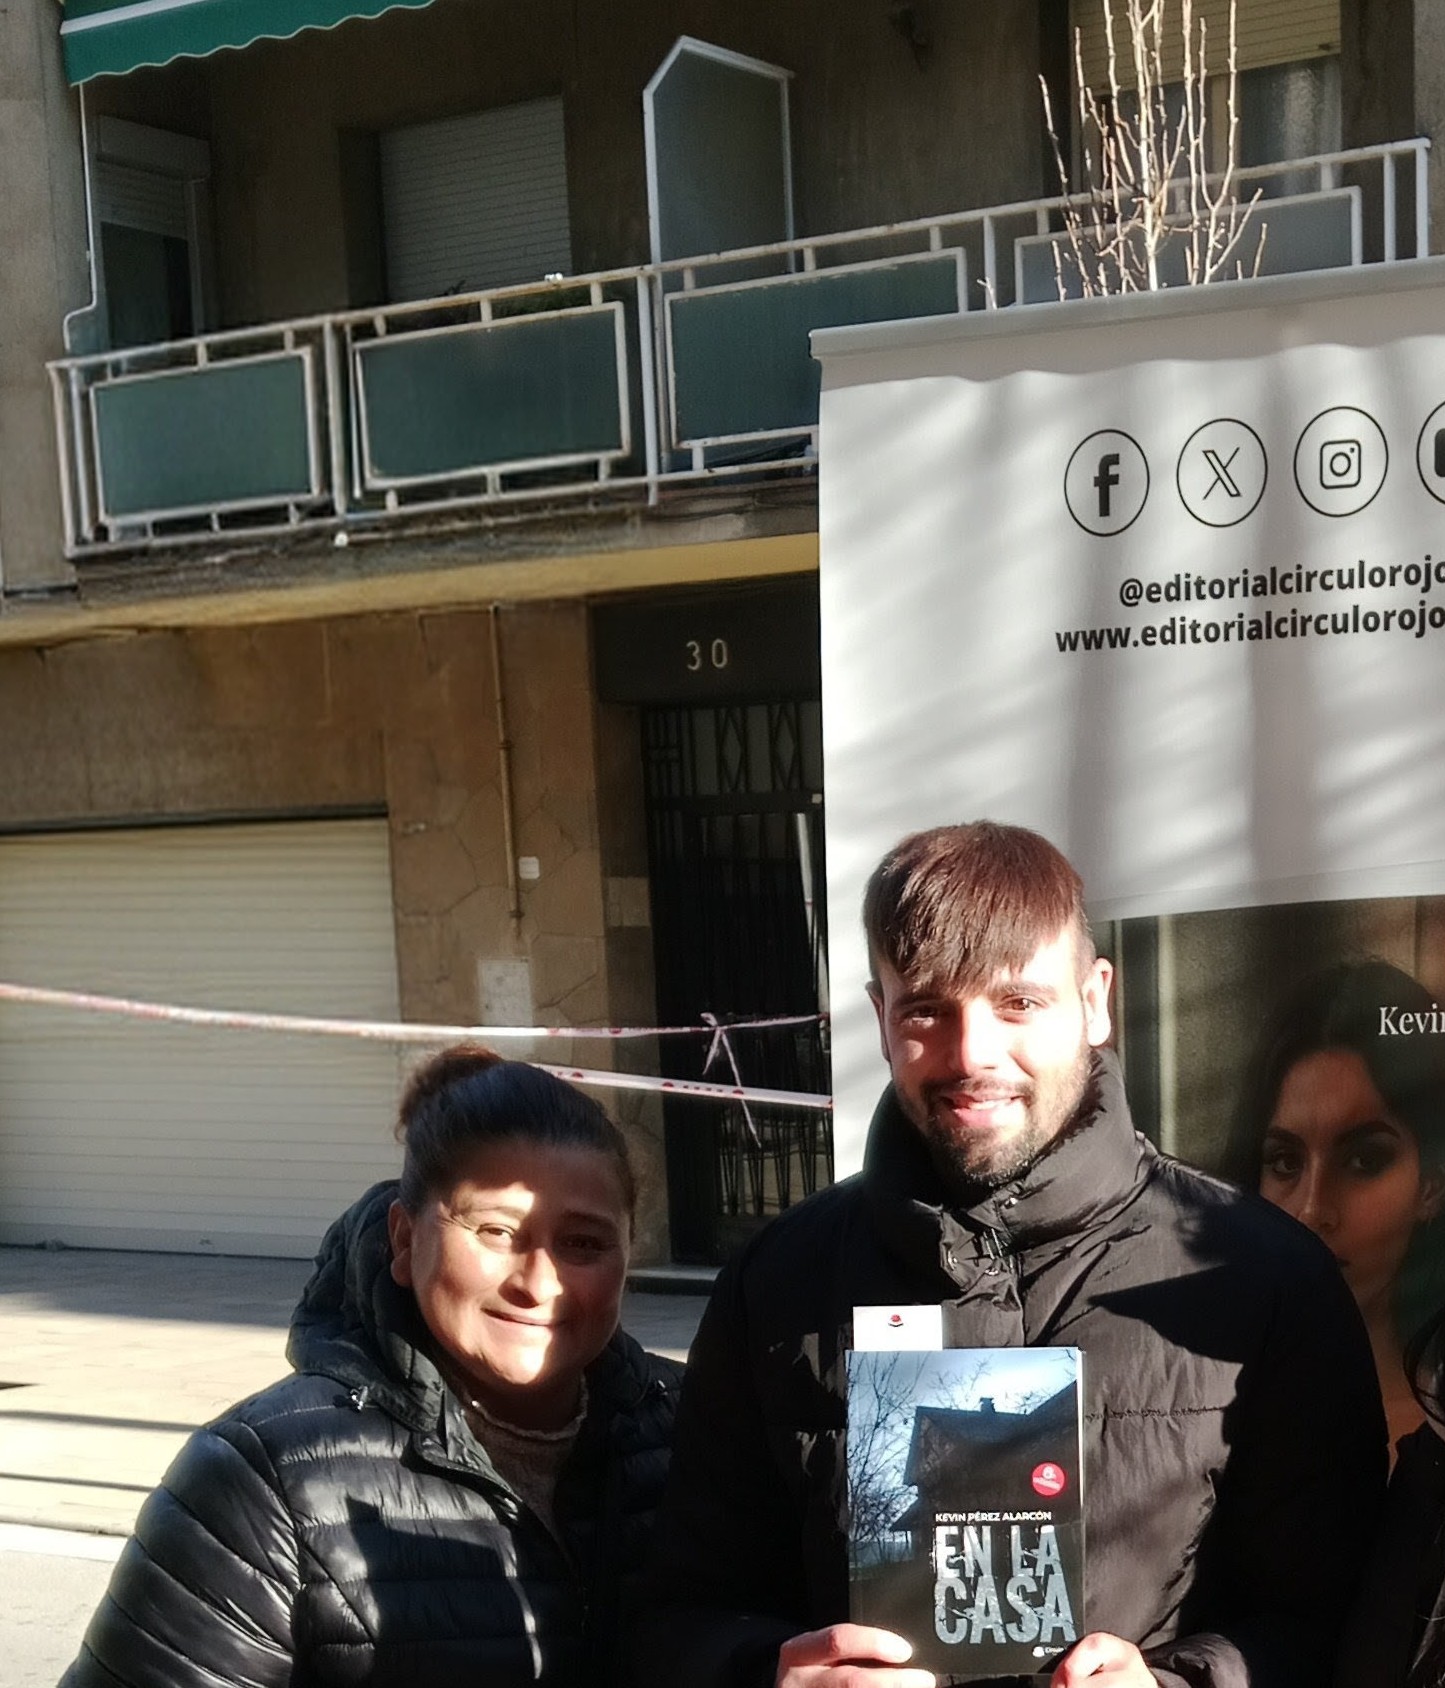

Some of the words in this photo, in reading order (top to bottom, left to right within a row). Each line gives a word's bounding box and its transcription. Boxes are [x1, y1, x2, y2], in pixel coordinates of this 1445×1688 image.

[686, 639, 728, 670] 30
[935, 1512, 967, 1523] KEVIN
[967, 1510, 1001, 1522] PÉREZ
[1001, 1509, 1052, 1522] ALARCÓN
[934, 1525, 992, 1578] EN
[1011, 1525, 1063, 1576] LA
[934, 1573, 1077, 1644] CASA
